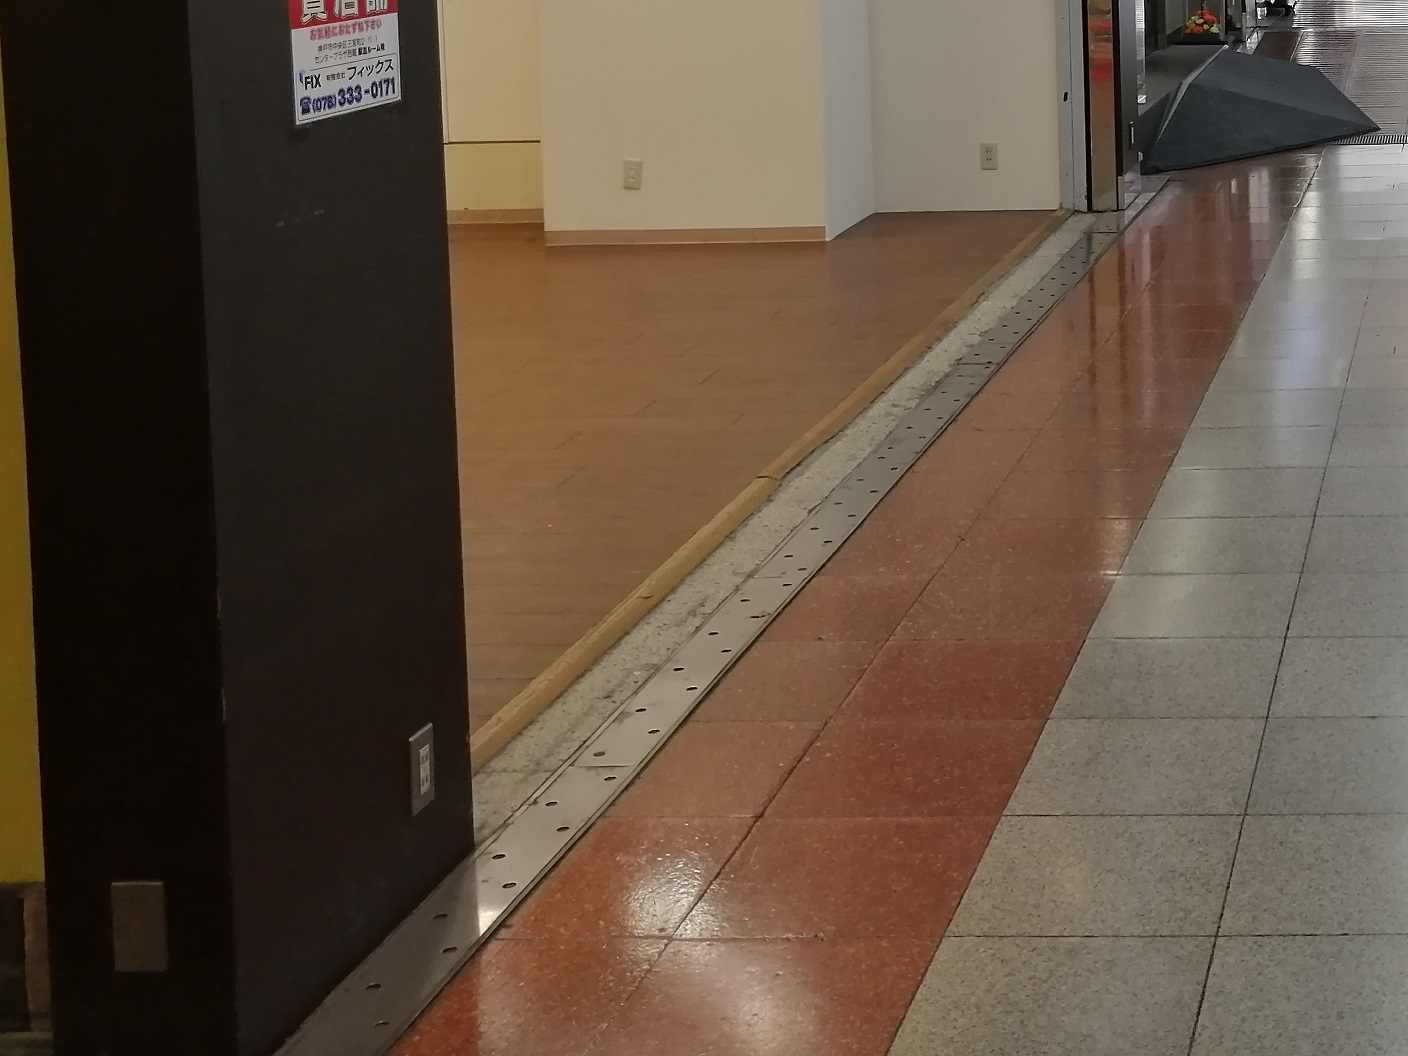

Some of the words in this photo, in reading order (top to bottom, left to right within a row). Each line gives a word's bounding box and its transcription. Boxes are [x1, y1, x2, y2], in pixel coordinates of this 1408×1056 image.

[304, 73, 322, 91] FIX
[347, 58, 394, 81] フィックス
